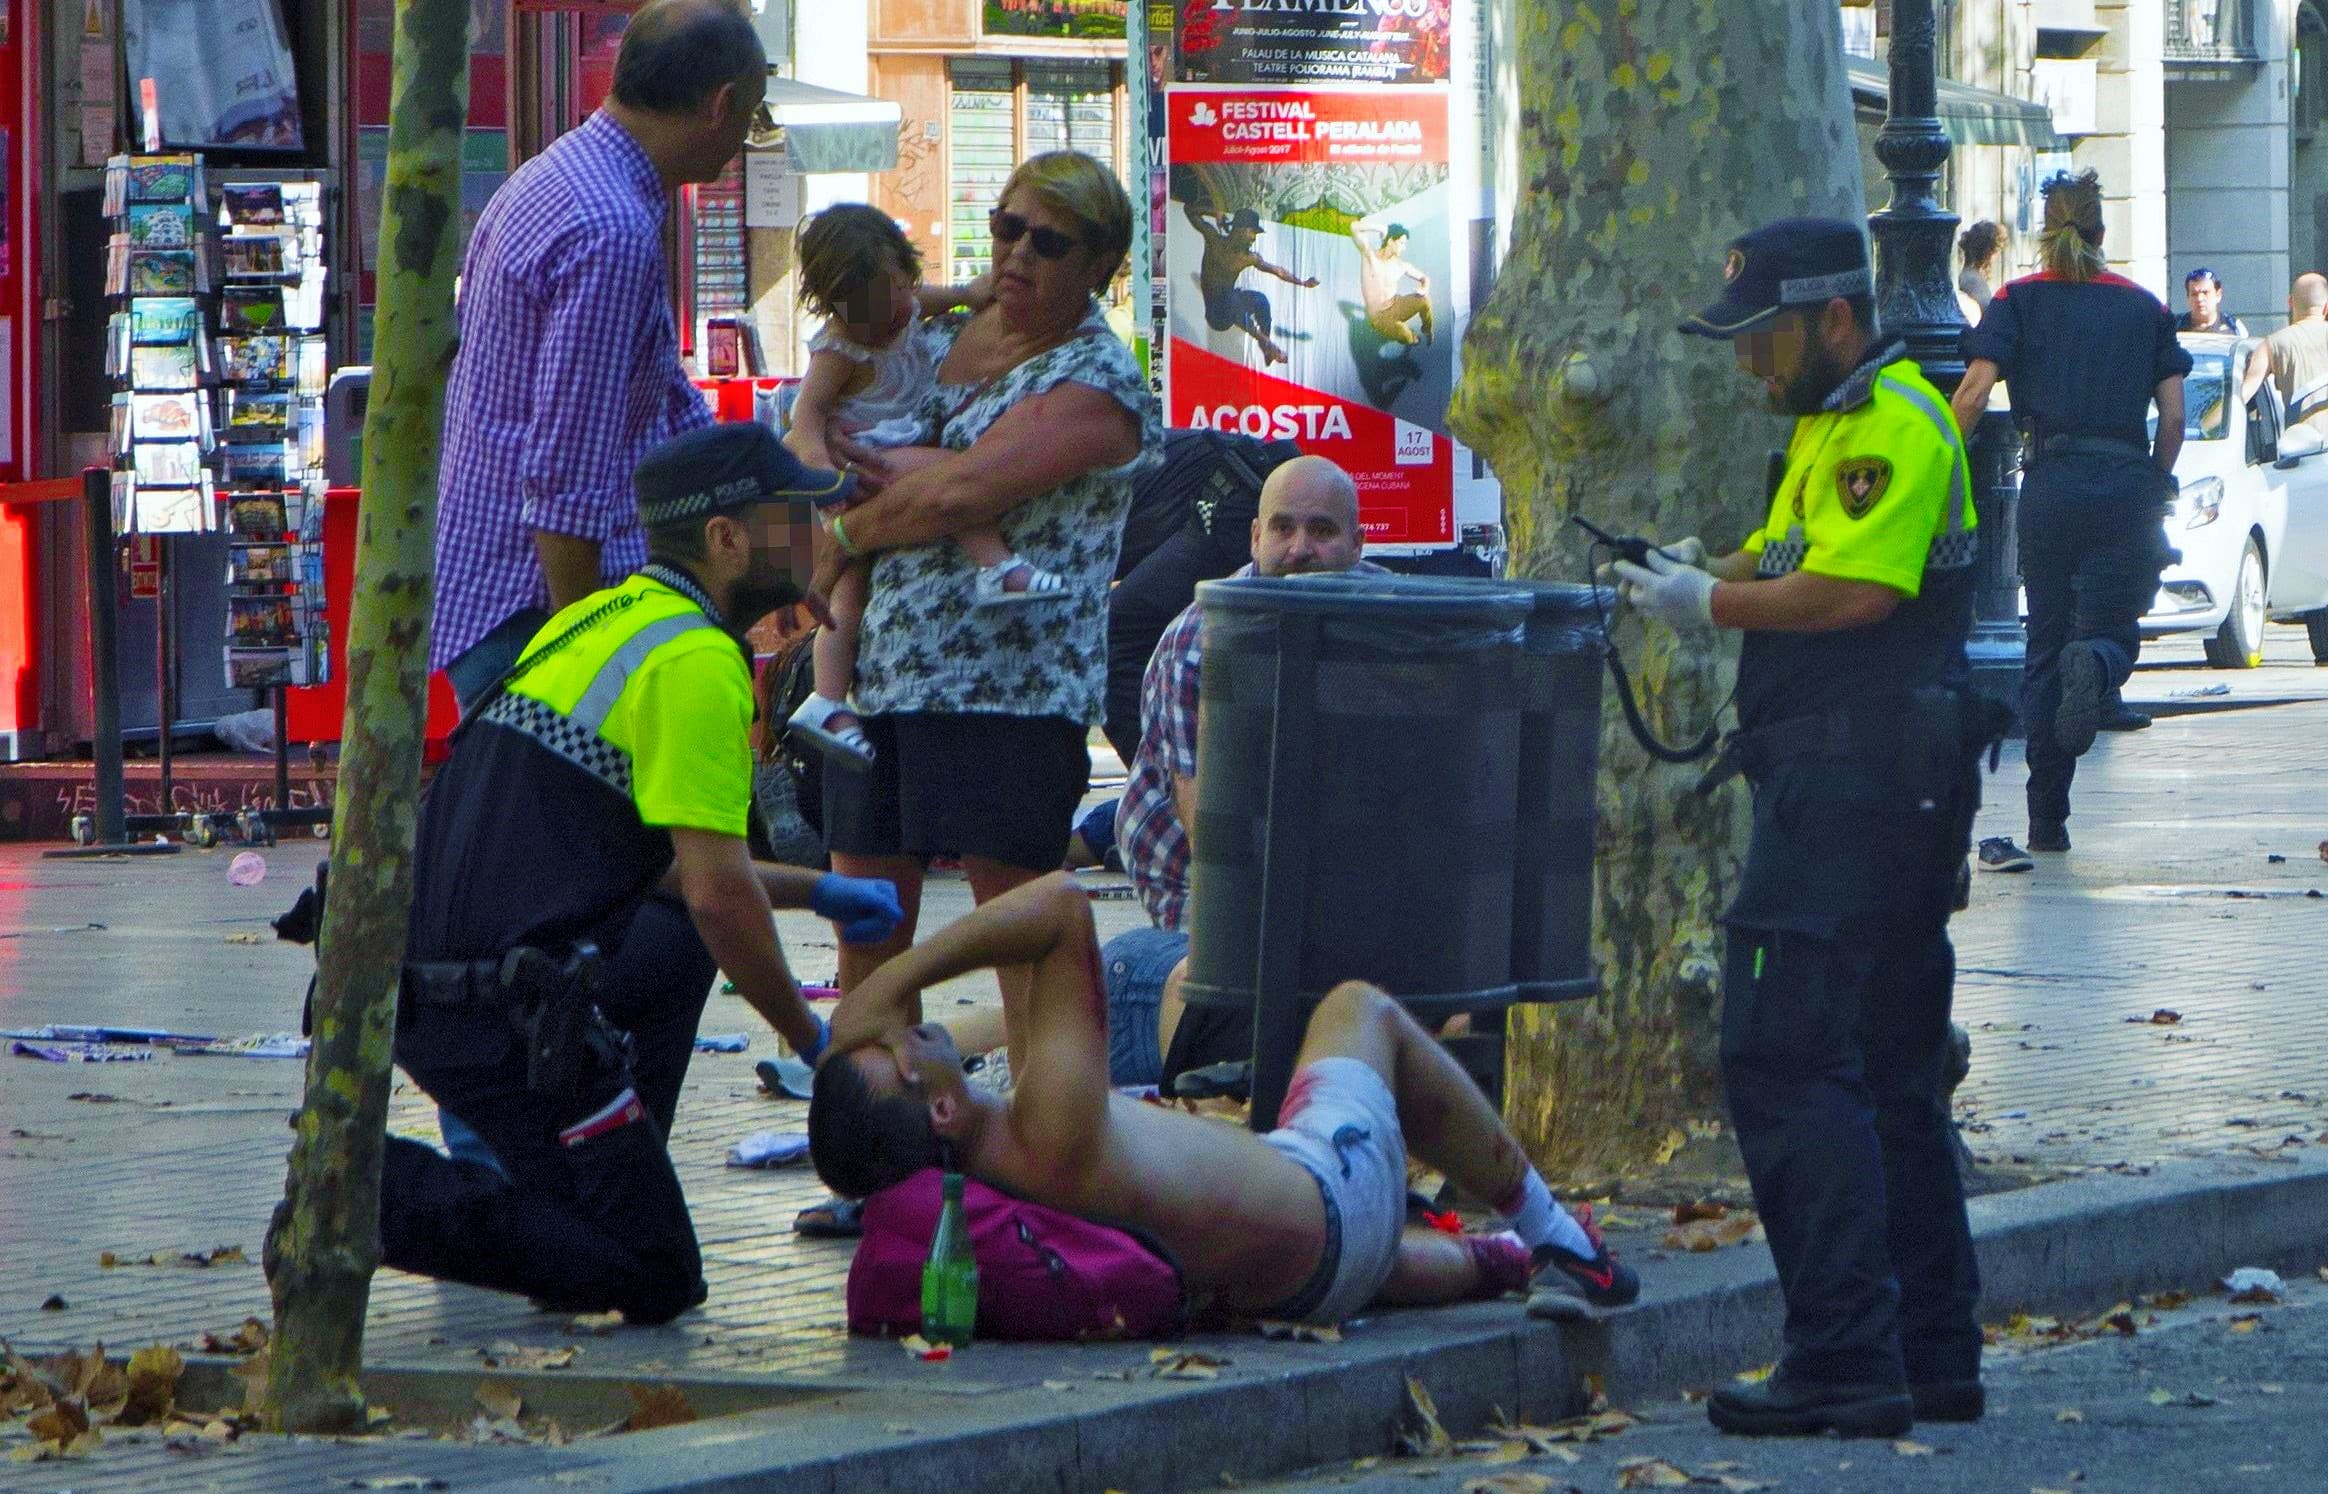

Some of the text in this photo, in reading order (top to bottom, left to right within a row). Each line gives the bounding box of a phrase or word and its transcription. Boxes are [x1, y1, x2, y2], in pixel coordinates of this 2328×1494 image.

[1241, 48, 1273, 58] PALAU
[1274, 49, 1289, 60] DE
[1290, 50, 1303, 60] LA
[1346, 51, 1401, 64] CATALANA
[1253, 62, 1288, 74] TEATRE
[1222, 101, 1316, 119] FESTIVAL
[1222, 120, 1422, 140] CASTELL PERALADA
[1268, 144, 1292, 155] 2017
[1189, 404, 1353, 440] ACOSTA
[1406, 431, 1423, 444] 17
[1398, 446, 1430, 457] AGOST
